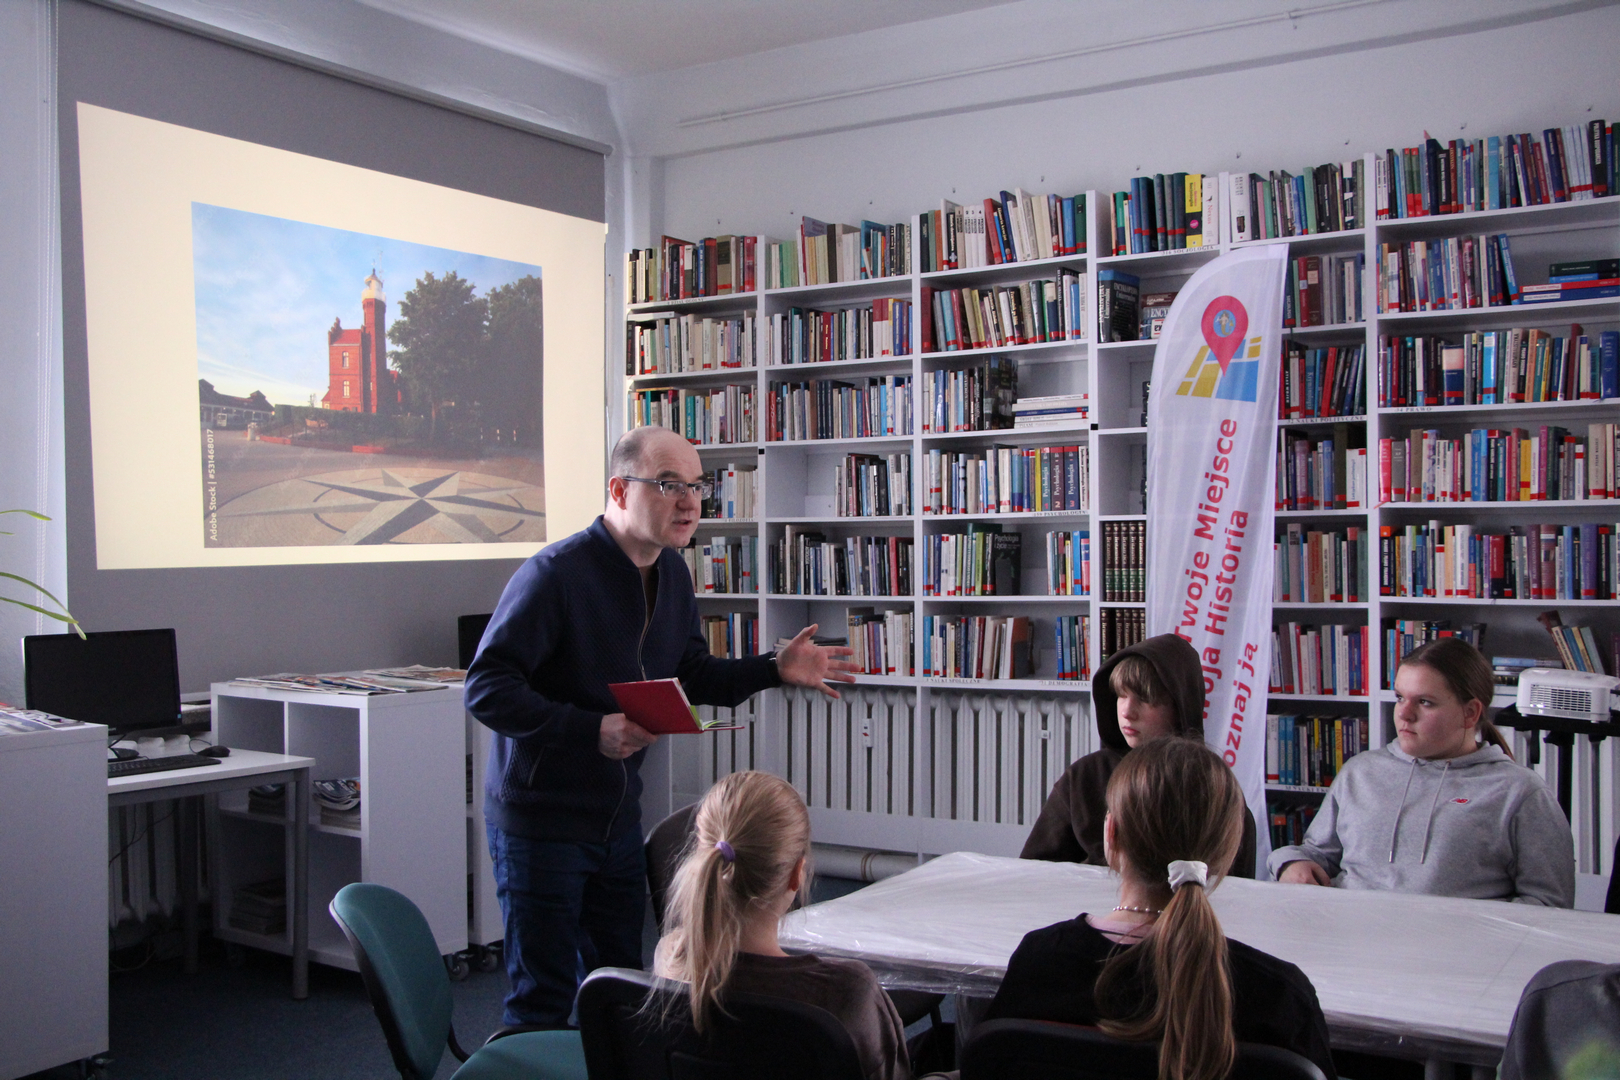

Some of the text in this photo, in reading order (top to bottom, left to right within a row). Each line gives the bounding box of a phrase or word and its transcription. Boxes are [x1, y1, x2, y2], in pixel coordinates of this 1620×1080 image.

[207, 428, 216, 479] #531468017
[1042, 466, 1050, 498] Psychologia
[1053, 464, 1061, 496] Psychologia
[1067, 463, 1076, 495] Psychologia
[208, 486, 217, 511] Stock
[209, 512, 218, 541] Adobe
[1174, 419, 1237, 643] Twoje Miejsce
[1201, 510, 1248, 719] oja Historia
[1223, 642, 1258, 768] oznaj ją
